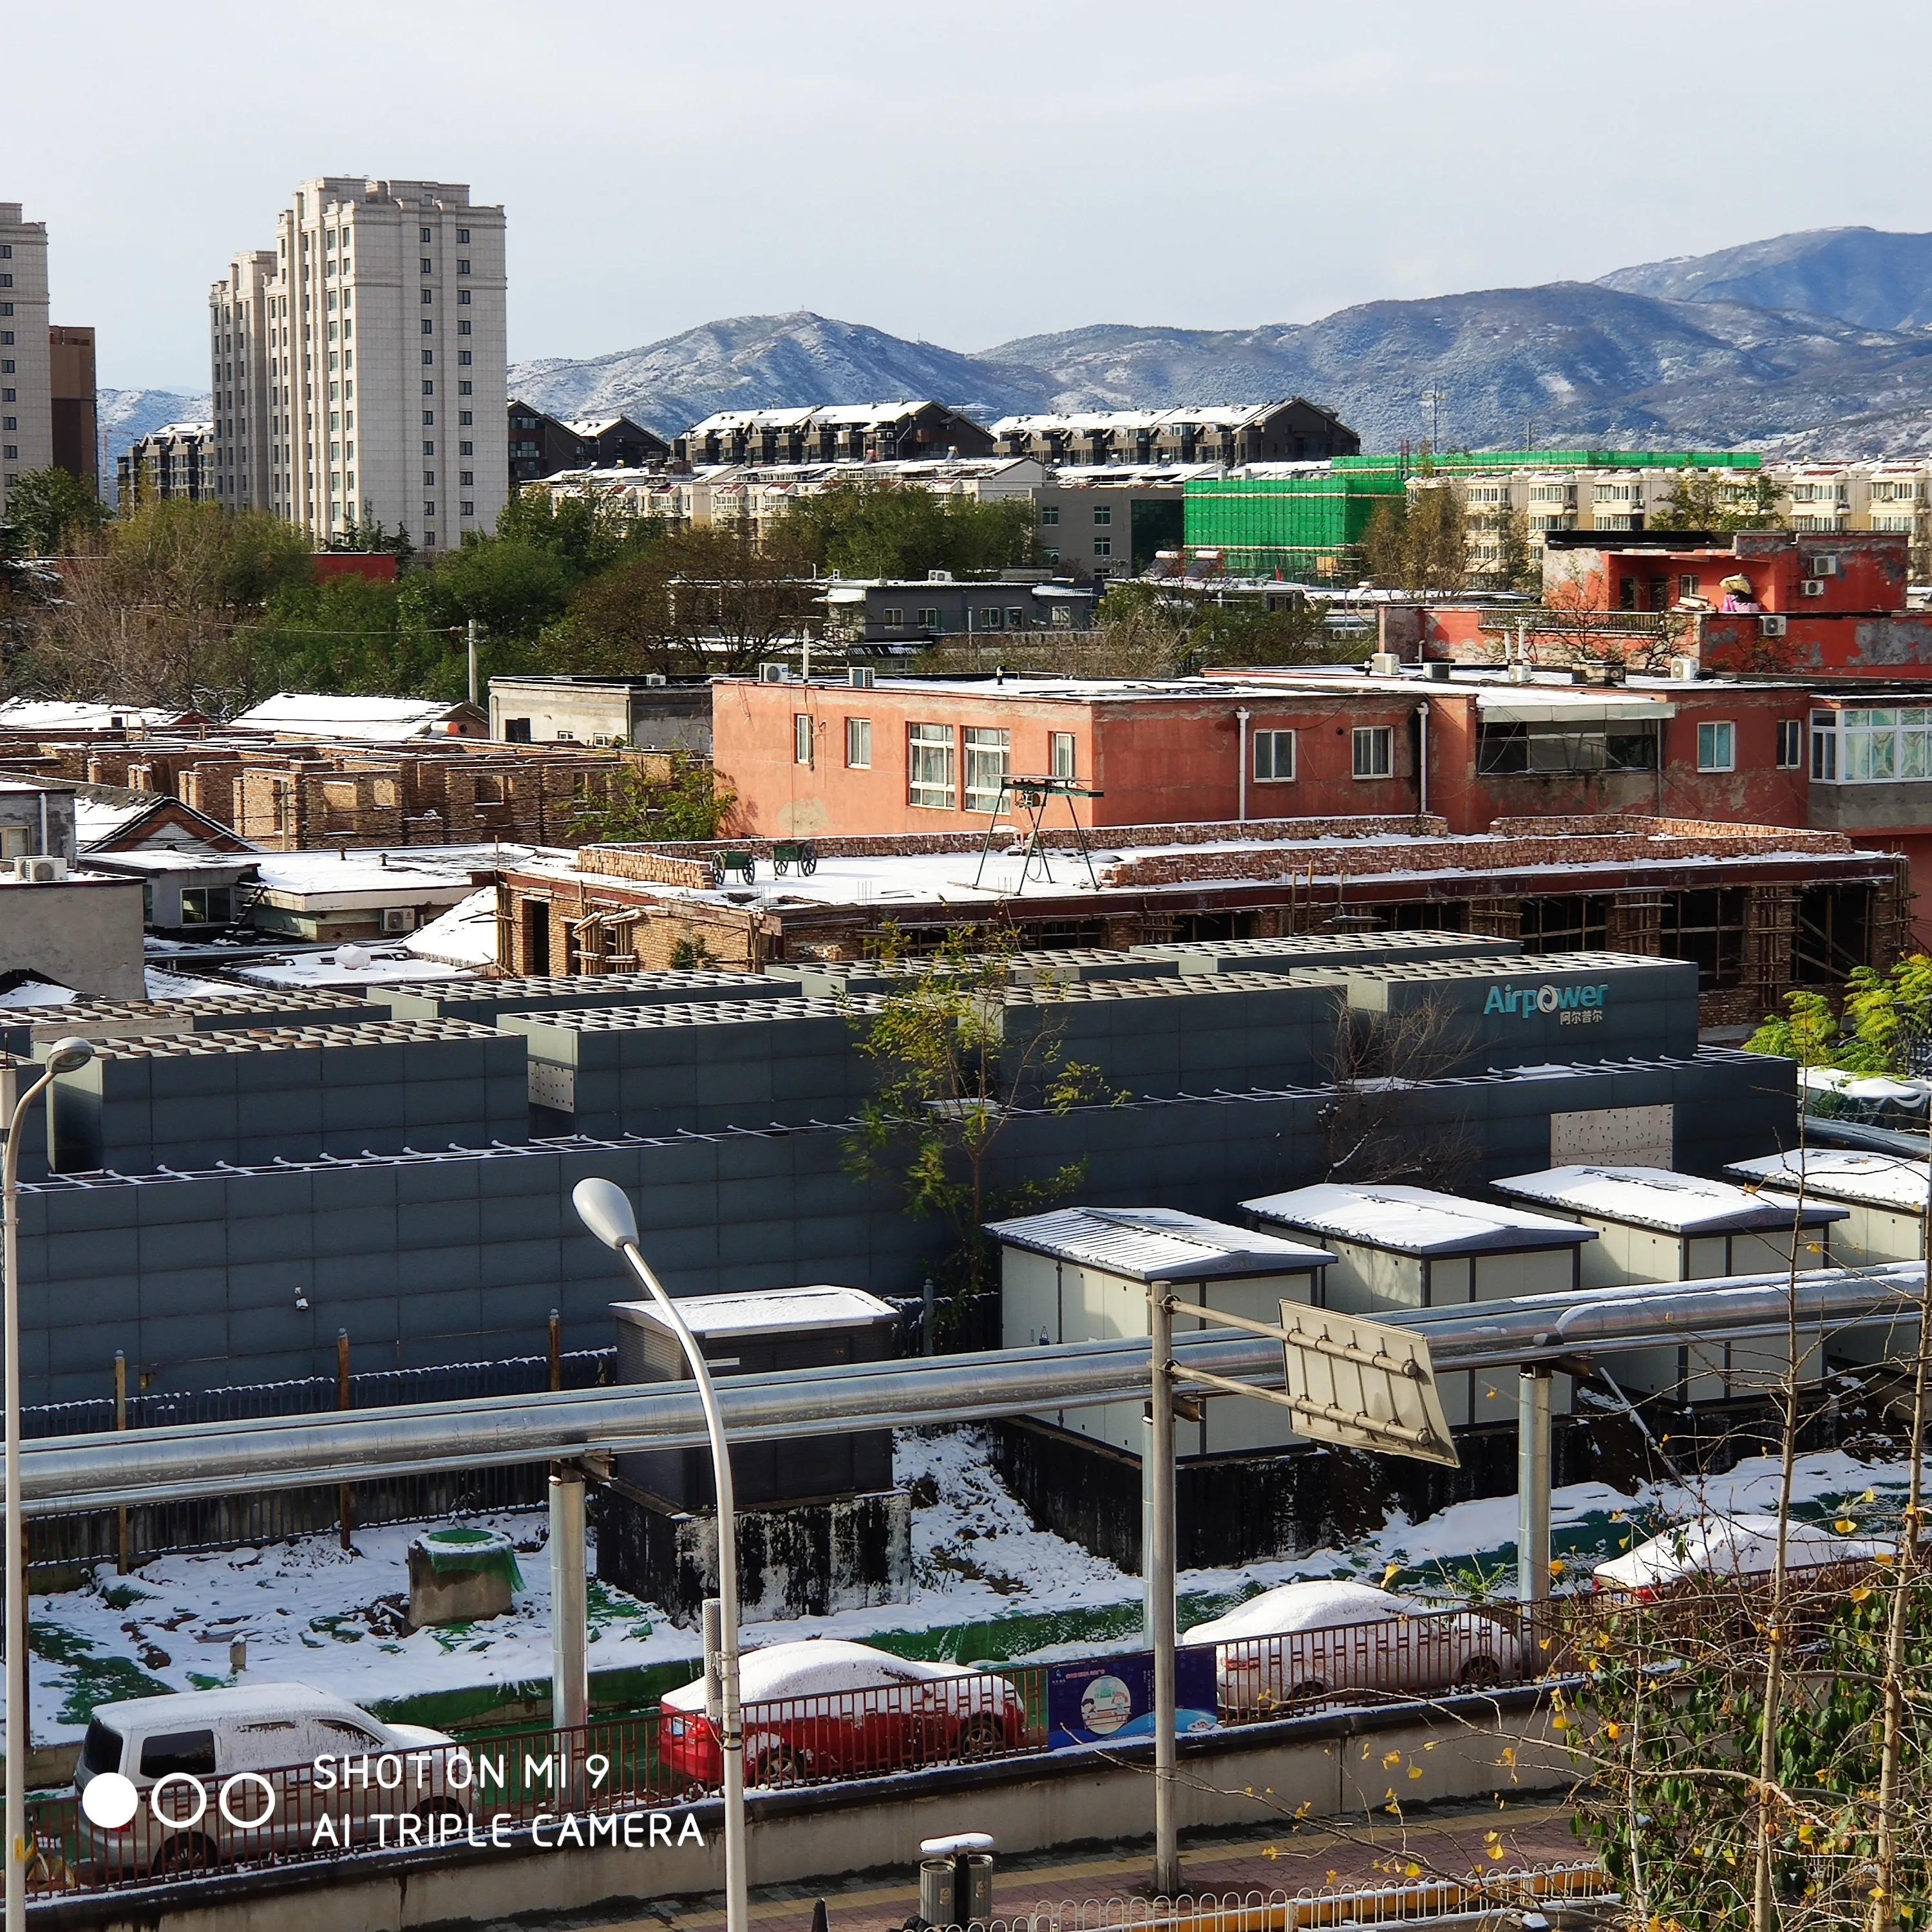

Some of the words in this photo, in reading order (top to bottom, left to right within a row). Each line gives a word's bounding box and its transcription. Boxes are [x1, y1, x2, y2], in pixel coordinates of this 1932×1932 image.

[1483, 984, 1608, 1018] Airpower
[1560, 1009, 1603, 1025] 阿尔普尔
